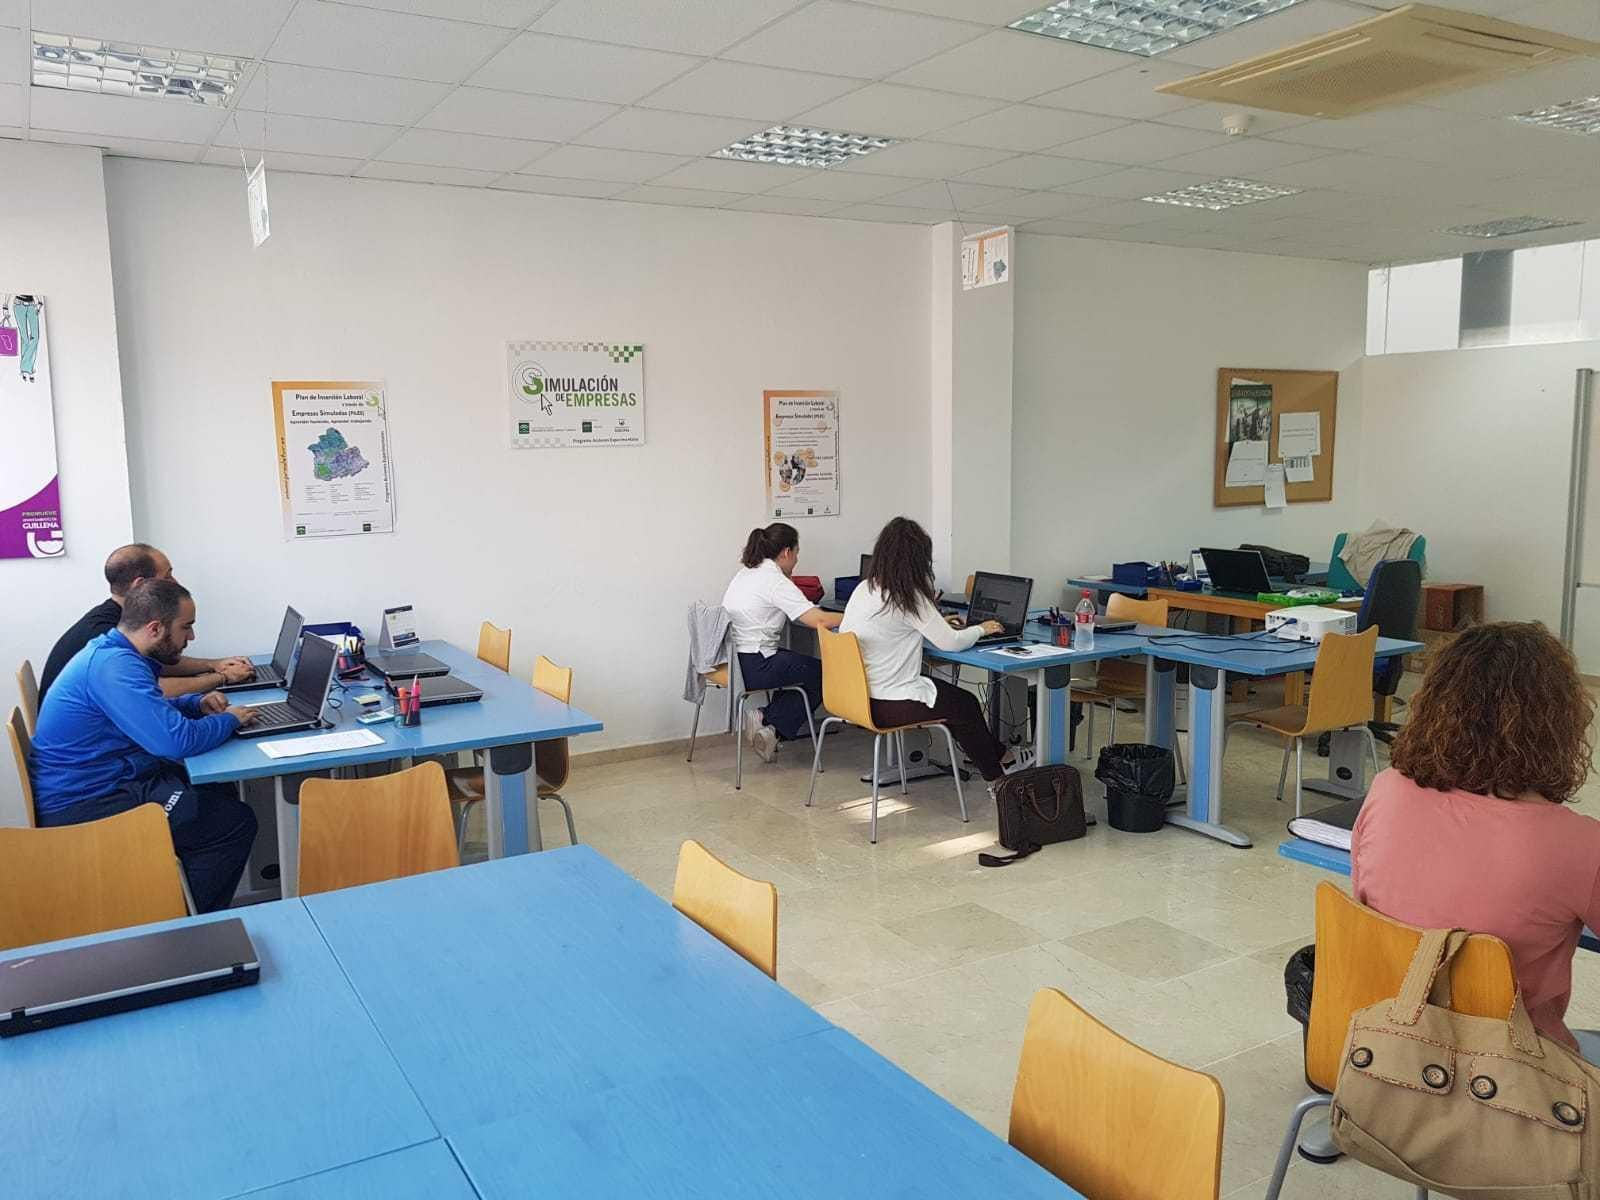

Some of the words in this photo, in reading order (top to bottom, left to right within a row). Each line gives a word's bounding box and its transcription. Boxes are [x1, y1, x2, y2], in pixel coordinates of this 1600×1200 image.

[522, 367, 618, 396] SIMULACIÓN
[555, 393, 565, 402] DE
[566, 392, 637, 408] EMPRESAS
[22, 521, 59, 529] GUILLENA
